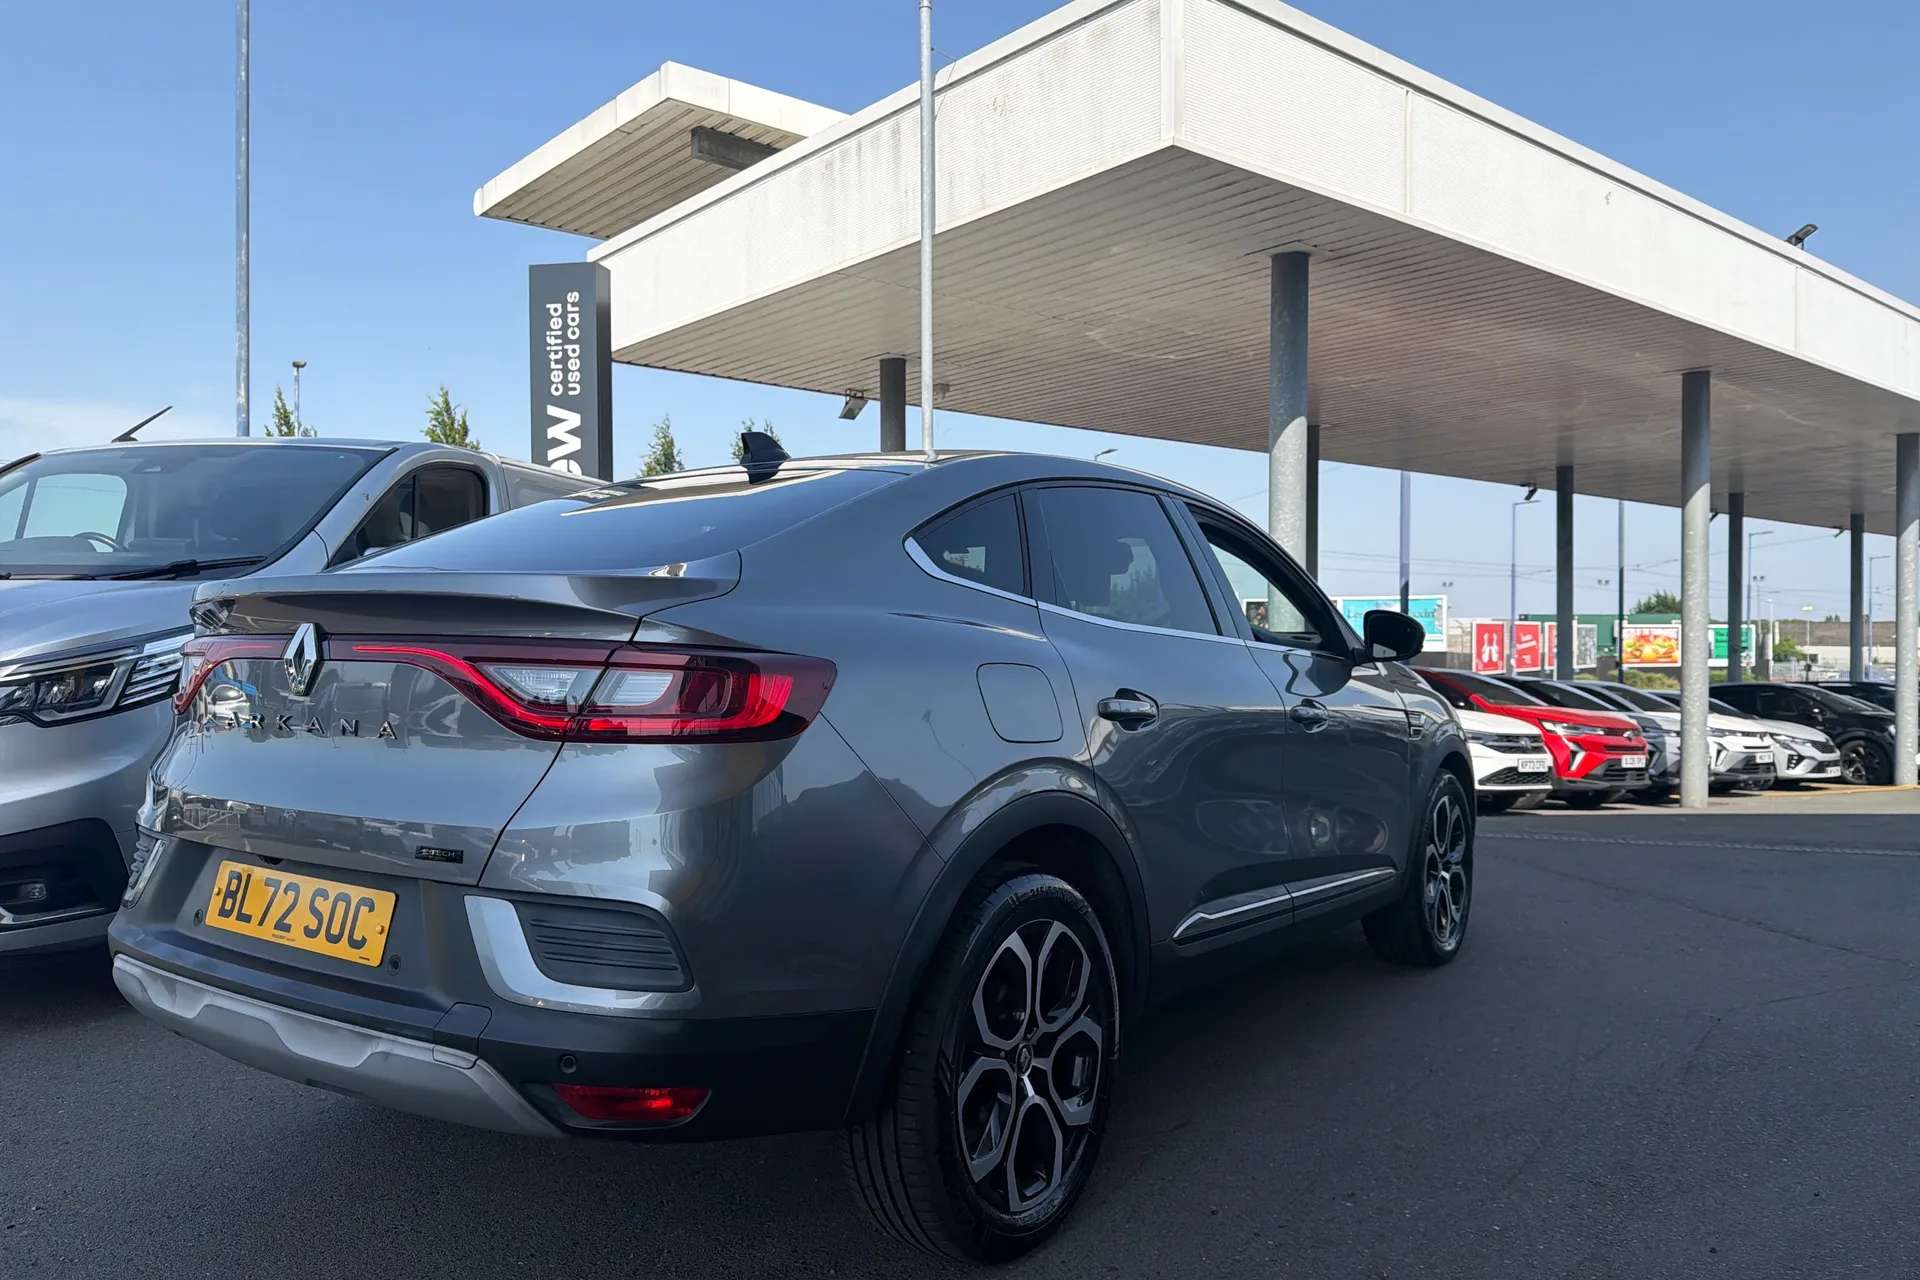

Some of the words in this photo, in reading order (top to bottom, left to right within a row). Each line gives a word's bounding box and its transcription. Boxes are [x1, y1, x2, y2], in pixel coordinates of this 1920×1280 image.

[567, 291, 580, 339] cars
[546, 303, 563, 396] certified
[564, 344, 581, 395] used
[224, 711, 399, 740] ARKANA
[217, 869, 301, 934] BL72
[303, 887, 376, 951] SOC
